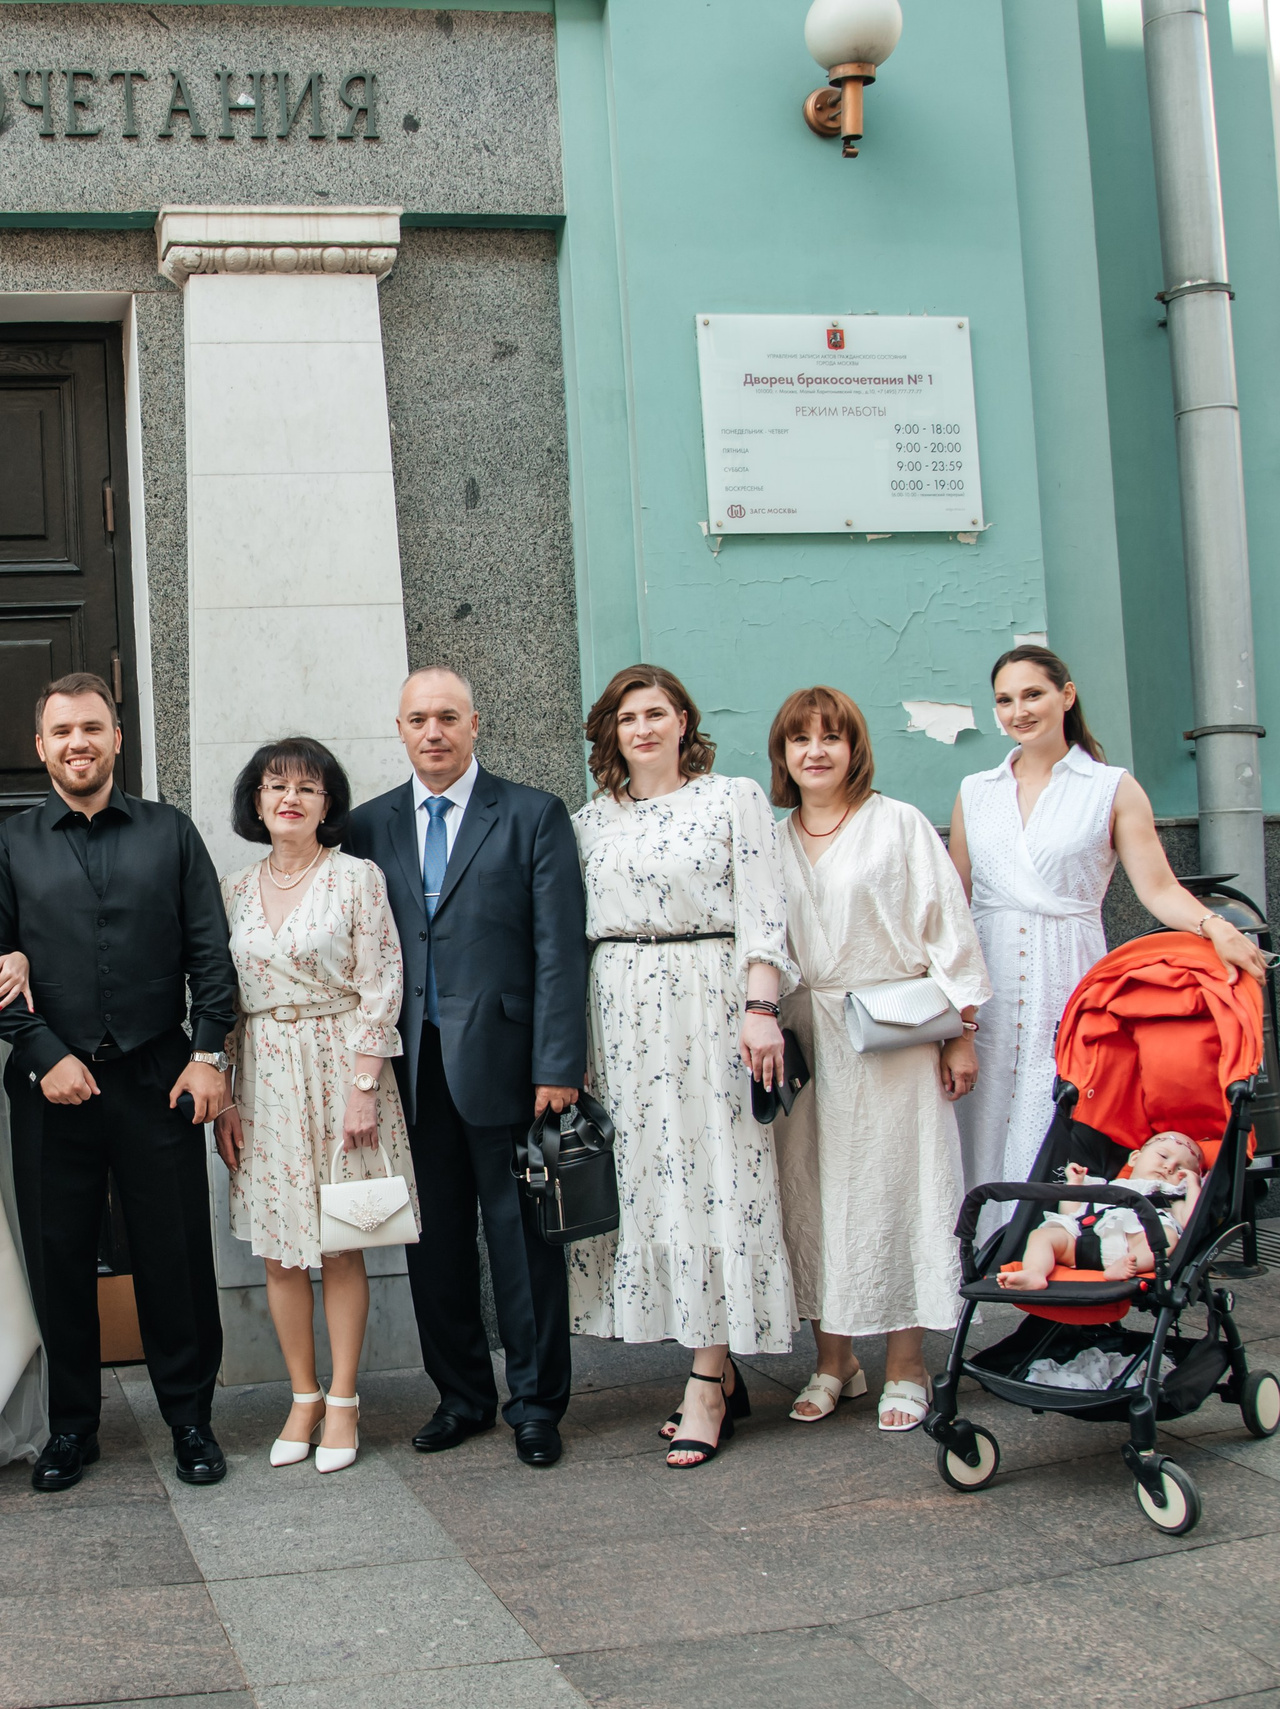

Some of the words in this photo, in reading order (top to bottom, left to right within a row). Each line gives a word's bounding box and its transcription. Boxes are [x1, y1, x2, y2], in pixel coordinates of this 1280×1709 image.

[743, 373, 795, 388] Дворец
[797, 372, 904, 388] бракосочетания
[907, 374, 923, 385] №
[927, 374, 933, 385] 1
[795, 406, 838, 417] РЕЖИМ
[842, 406, 887, 417] РАБОТЫ
[894, 423, 920, 434] 9:00
[931, 423, 960, 435] 18:00
[895, 442, 921, 453] 9:00
[930, 442, 961, 453] 20:00
[897, 461, 922, 472] 9:00
[931, 461, 963, 471] 23:59
[890, 480, 923, 491] 00:00
[934, 480, 964, 490] 19:00
